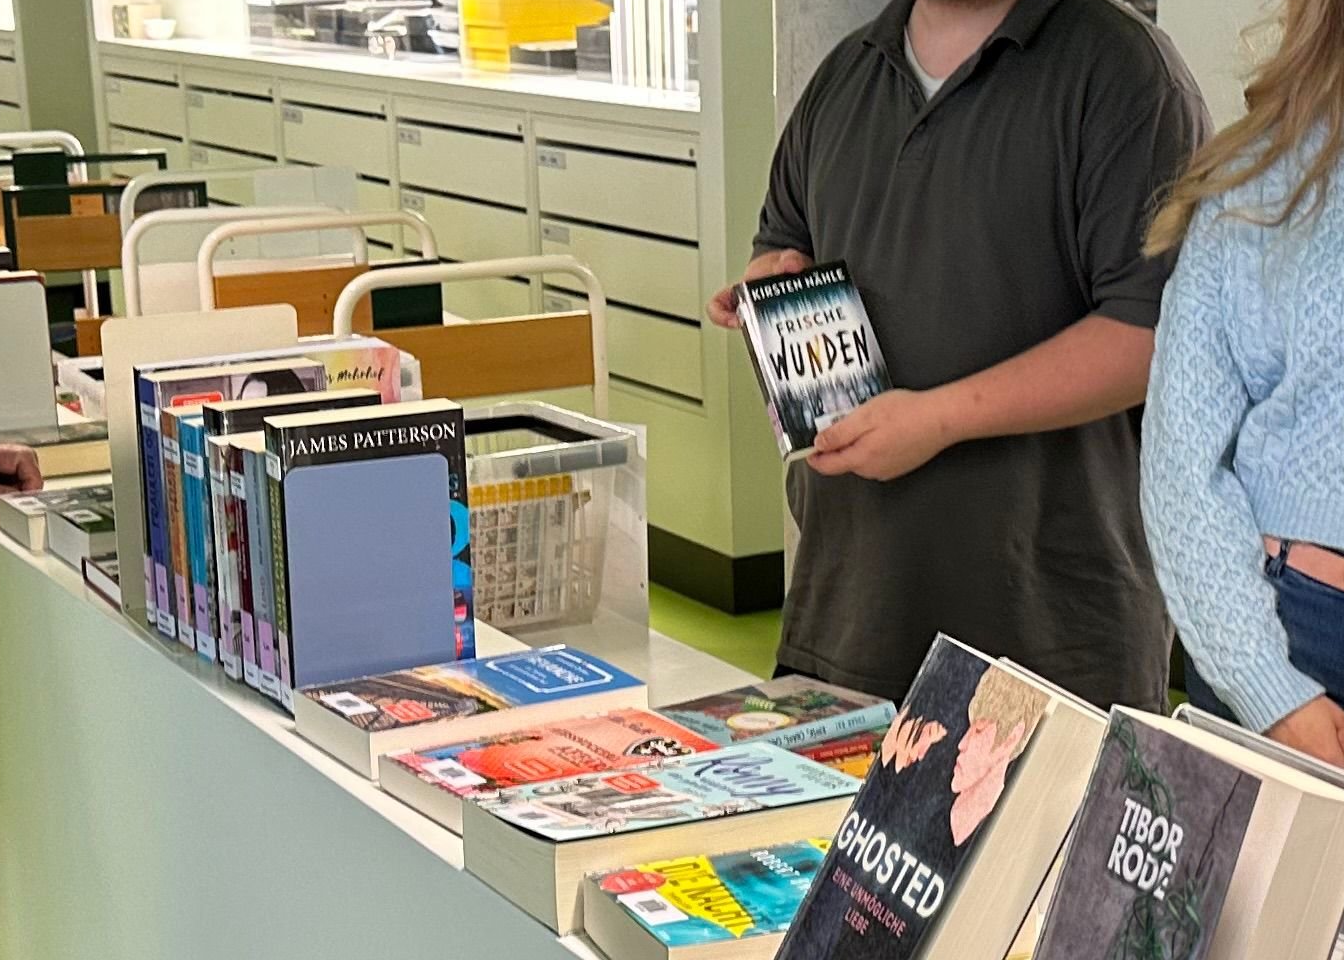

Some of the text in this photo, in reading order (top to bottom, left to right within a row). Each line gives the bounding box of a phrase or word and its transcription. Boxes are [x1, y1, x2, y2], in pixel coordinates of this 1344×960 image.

[751, 267, 846, 302] KIRSTEN NÄHLE
[775, 306, 847, 337] FRISCHE
[769, 323, 871, 381] WUNDEN
[289, 421, 456, 459] JAMES PATTERSON
[1120, 797, 1183, 863] TIBOR
[837, 811, 944, 918] GHOSTED
[1107, 833, 1173, 901] RODE
[832, 866, 906, 938] EINE UNMÖGLICHE
[844, 907, 870, 936] LIEBE
